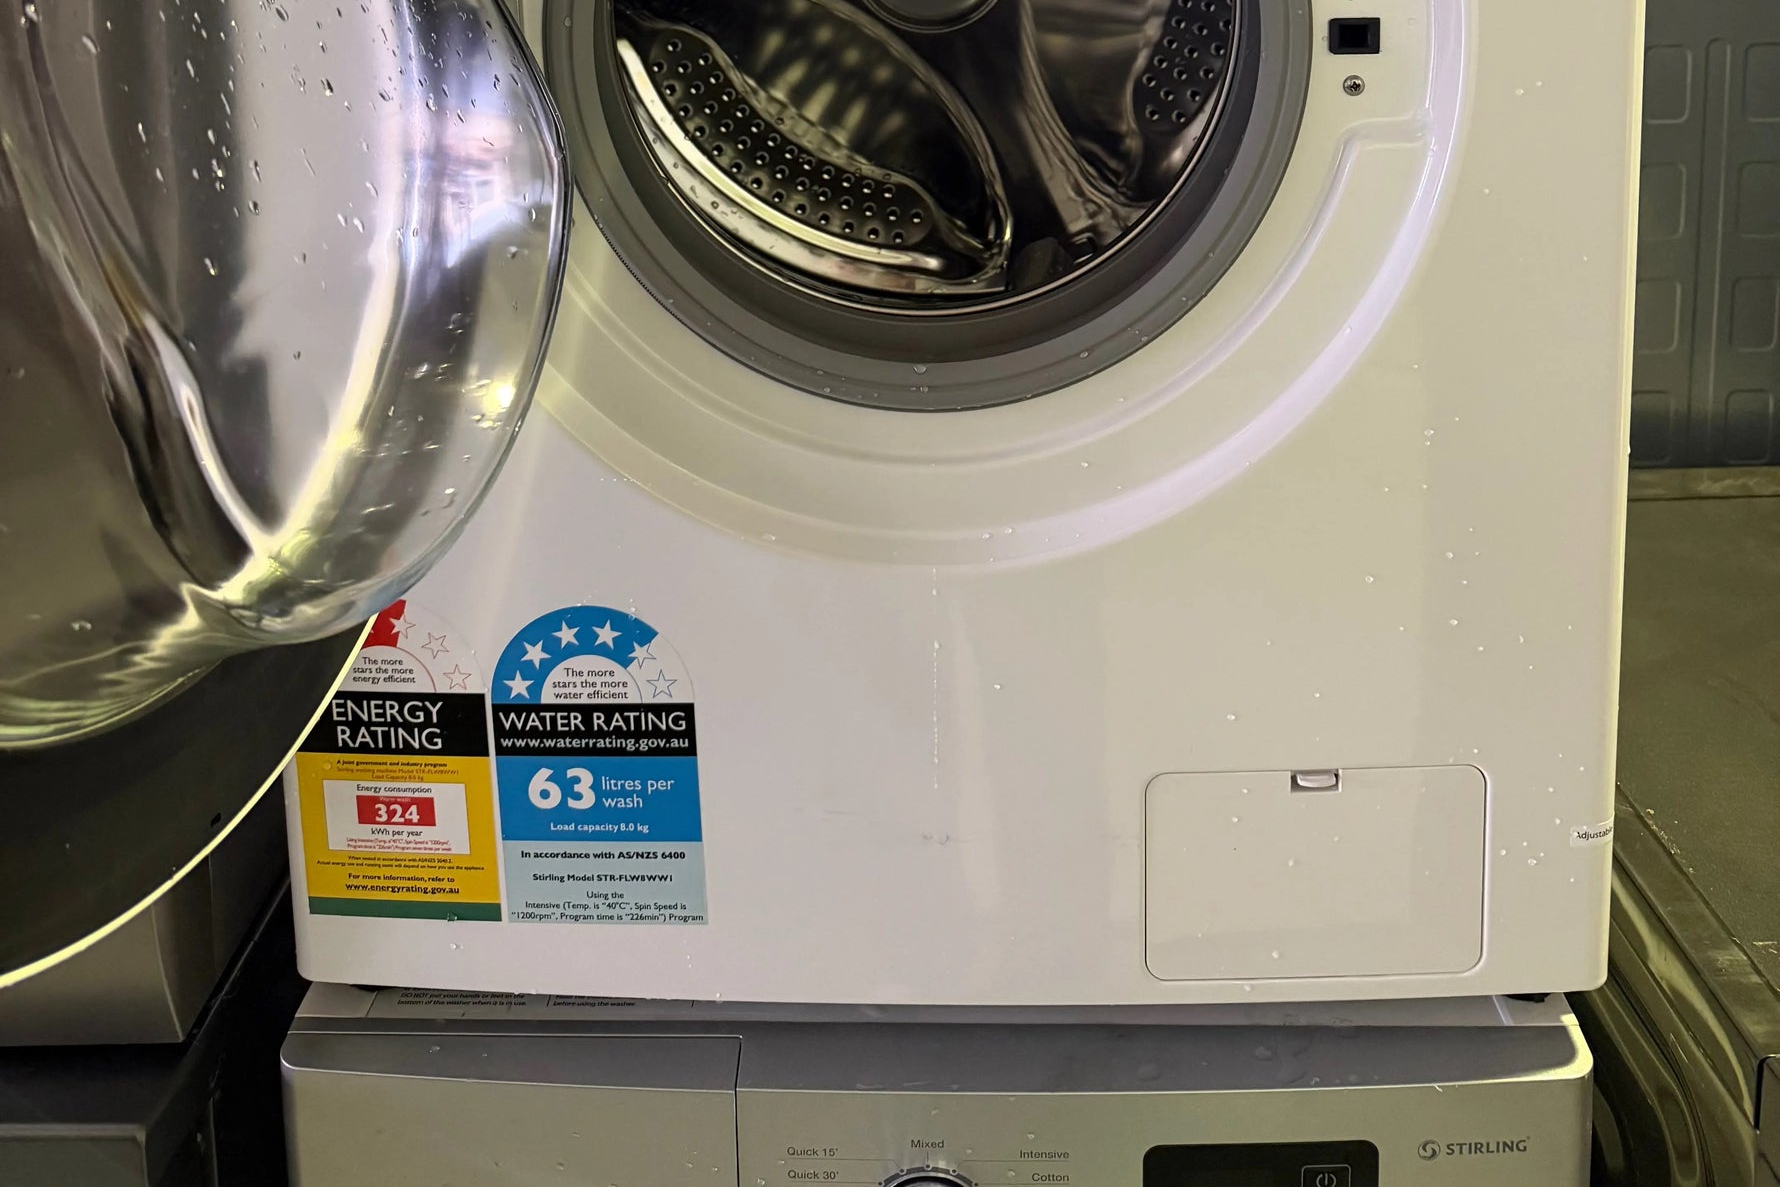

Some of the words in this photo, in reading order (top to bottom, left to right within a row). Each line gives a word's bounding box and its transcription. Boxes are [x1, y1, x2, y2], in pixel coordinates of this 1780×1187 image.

[362, 657, 378, 665] The
[380, 658, 404, 666] more
[353, 667, 372, 675] stars
[375, 666, 389, 675] the
[391, 668, 414, 676] more
[563, 668, 584, 677] The
[587, 669, 615, 678] more
[353, 675, 381, 685] energy
[383, 674, 416, 684] efficient
[552, 680, 577, 689] stars
[580, 679, 597, 689] the
[599, 680, 628, 689] more
[553, 691, 584, 700] water
[586, 690, 628, 700] efficient
[331, 699, 443, 723] ENERGY
[499, 712, 585, 732] WATER
[593, 711, 687, 732] RATING
[337, 726, 443, 750] RATING
[500, 736, 689, 751] www.waterrating.gov.au
[356, 784, 382, 794] Energy
[384, 785, 432, 795] consumption
[528, 767, 596, 810] 63
[602, 777, 642, 791] litres
[647, 779, 675, 795] per
[602, 794, 643, 808] wash
[375, 803, 420, 824] 324
[371, 827, 390, 836] kWh
[392, 830, 404, 838] per
[407, 830, 423, 839] year
[550, 822, 575, 832] Load
[578, 822, 619, 834] capacity
[620, 823, 635, 832] 8.0
[637, 823, 650, 834] kg
[521, 850, 531, 859] In
[533, 850, 591, 859] accordance
[593, 850, 616, 859] with
[617, 850, 659, 860] AS/NZS
[661, 850, 686, 860] 6400
[383, 874, 427, 883] information,
[532, 873, 566, 883] Stirling
[567, 873, 595, 882] Model
[345, 882, 460, 895] www.energyrating.gov.au
[586, 891, 609, 901] Using
[611, 890, 625, 899] the
[525, 901, 560, 910] Intensive
[562, 900, 591, 912] (Temp.
[593, 901, 600, 910] is
[635, 901, 652, 912] Spin
[653, 901, 679, 912] Speed
[680, 901, 687, 911] is
[560, 912, 595, 923] Program
[596, 912, 615, 921] time
[616, 912, 623, 921] is
[668, 913, 704, 923] Program
[910, 1139, 944, 1149] Mixed
[1446, 1139, 1528, 1156] STIRLING
[787, 1147, 819, 1158] Quick
[1019, 1149, 1070, 1159] Intensive
[787, 1170, 820, 1181] Quick
[1032, 1172, 1070, 1183] Cotton
